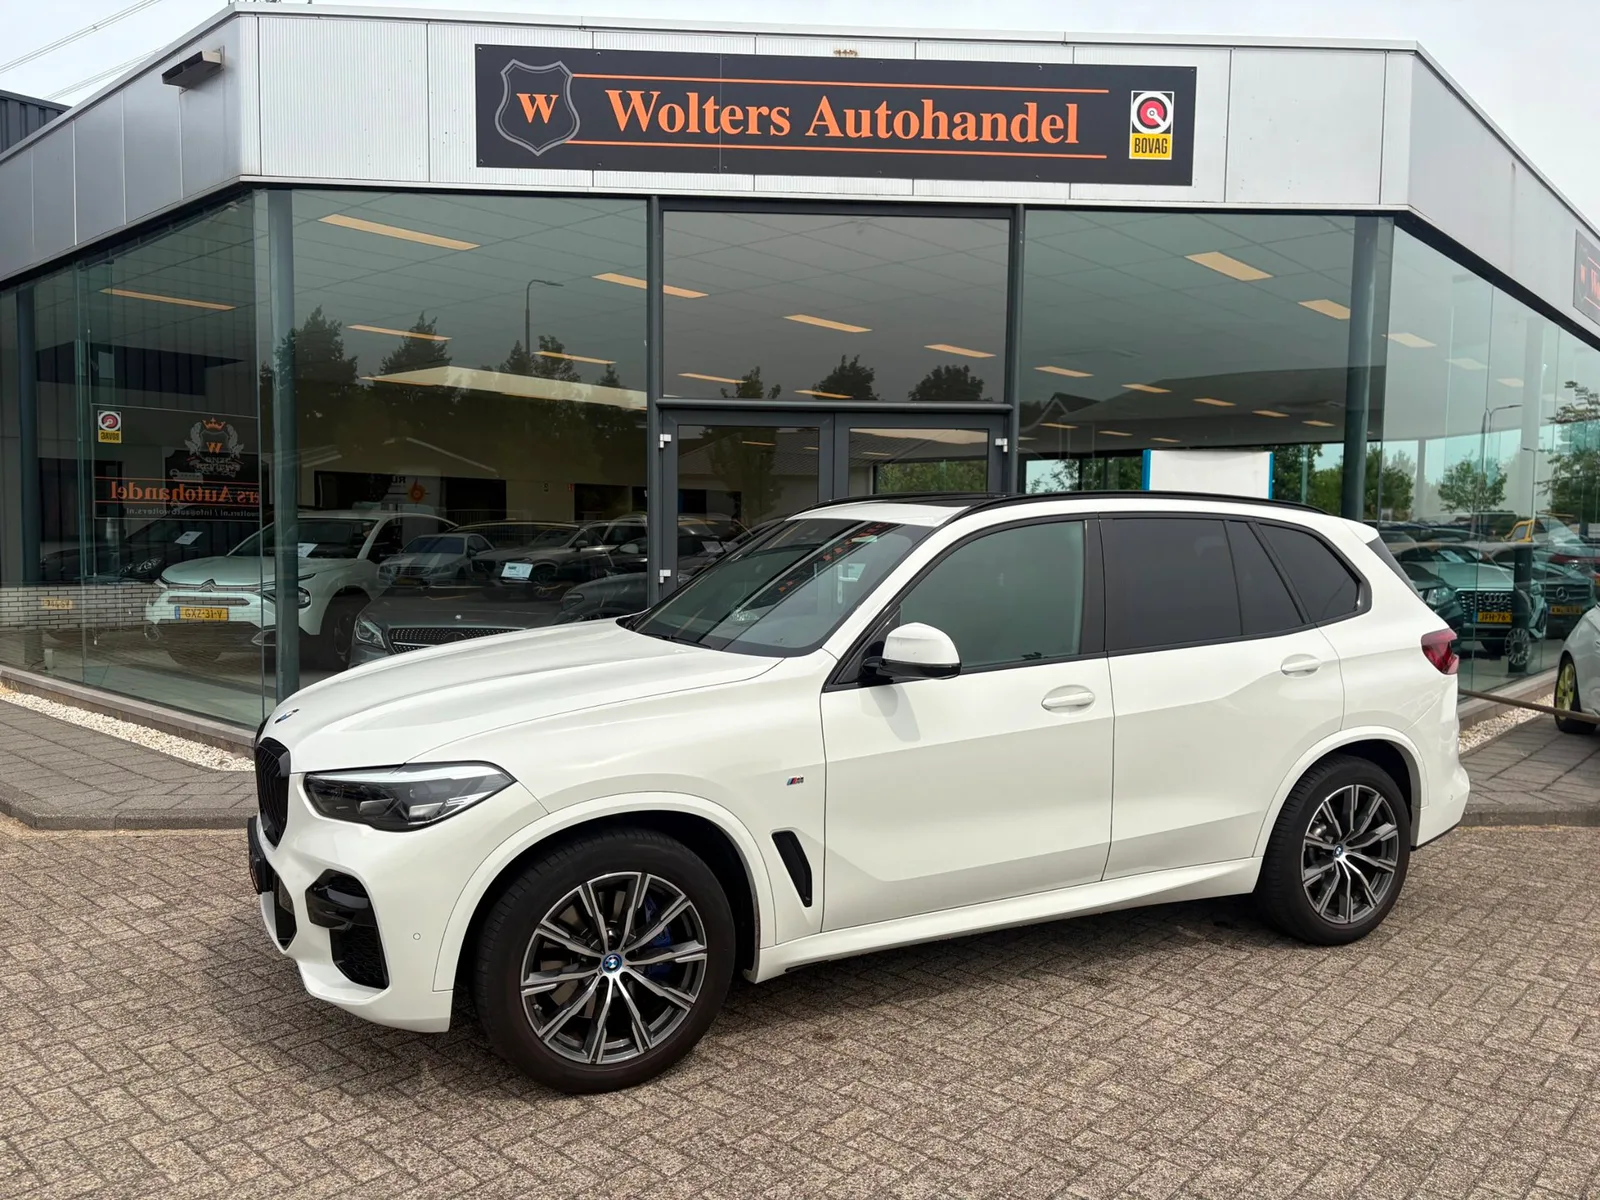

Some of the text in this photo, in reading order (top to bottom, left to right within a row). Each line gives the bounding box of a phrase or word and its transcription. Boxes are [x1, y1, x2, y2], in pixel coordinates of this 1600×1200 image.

[516, 93, 559, 123] W
[605, 89, 1079, 144] Wolters Autohandel
[1133, 138, 1168, 154] BOVAG
[1480, 613, 1512, 621] JFH-76-
